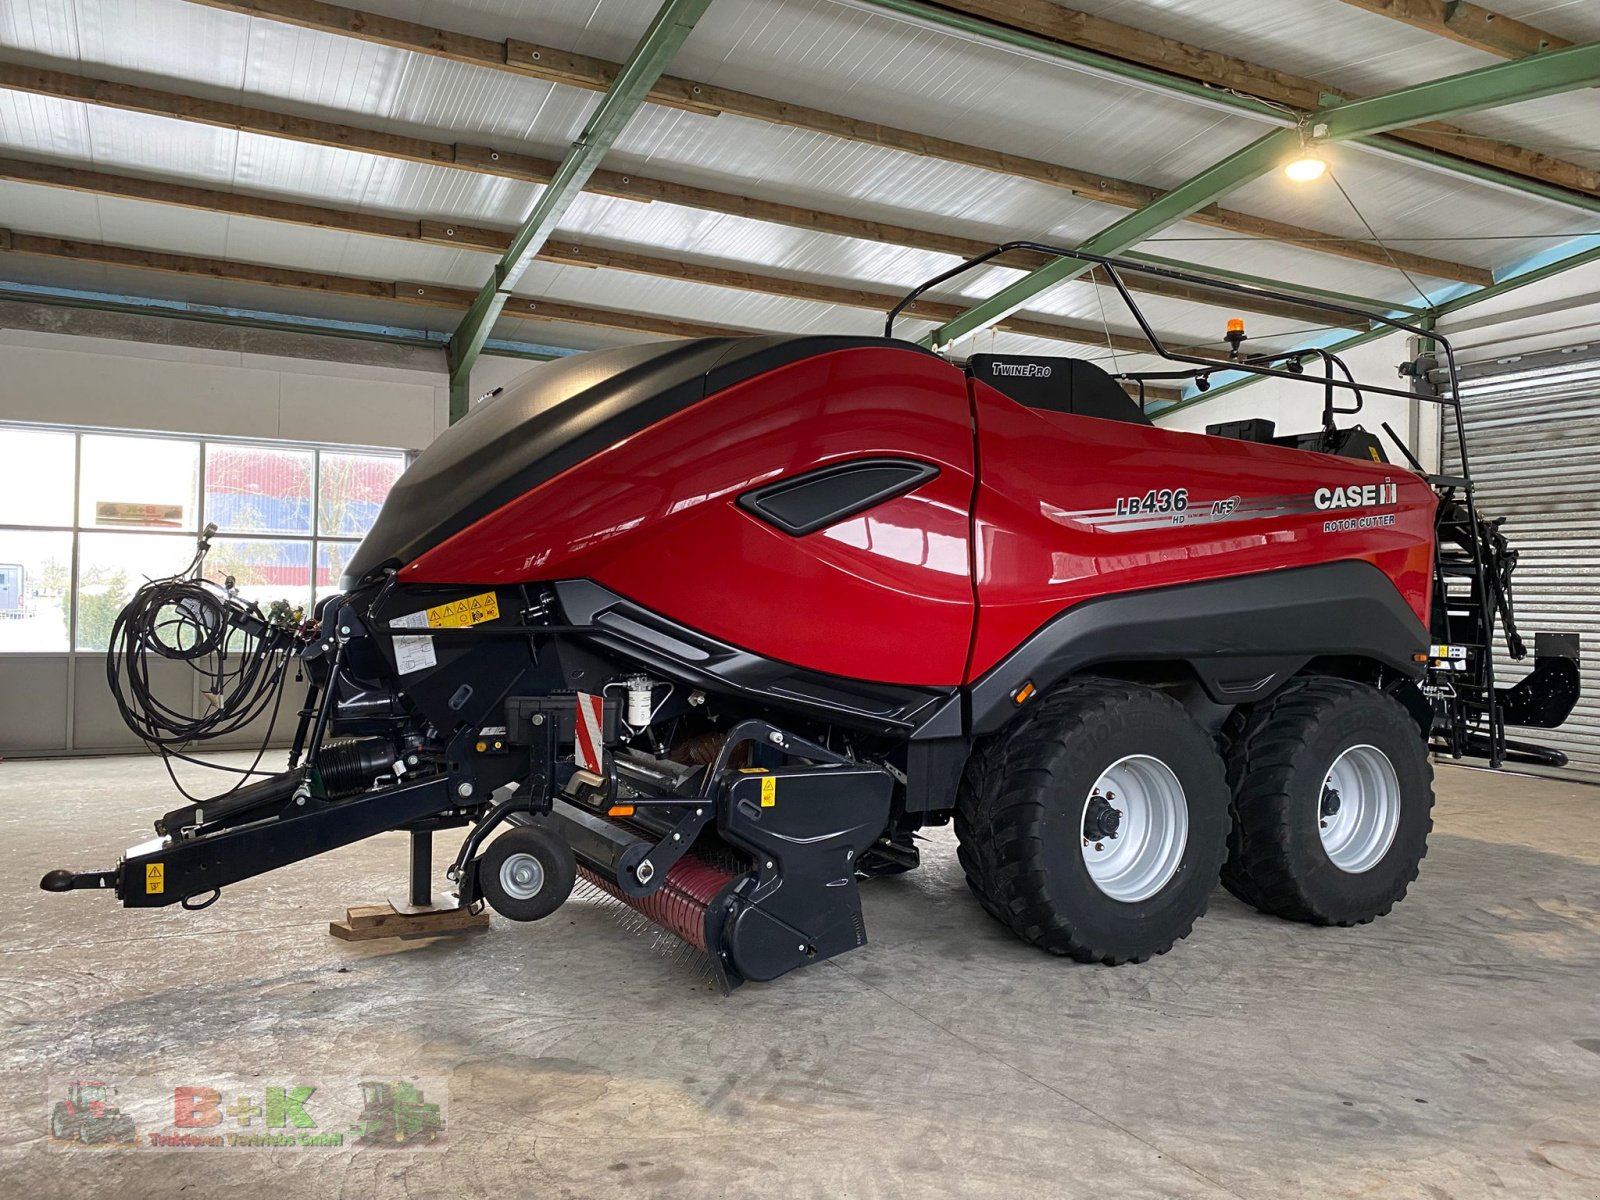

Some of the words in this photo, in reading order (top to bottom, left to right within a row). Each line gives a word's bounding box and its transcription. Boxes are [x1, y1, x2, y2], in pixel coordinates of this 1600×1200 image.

[1116, 488, 1189, 517] LB436
[1314, 485, 1376, 510] CASE
[1211, 499, 1235, 517] AFS
[1172, 515, 1185, 524] HD
[1323, 519, 1357, 533] ROTOR
[1359, 514, 1395, 527] CUTTER
